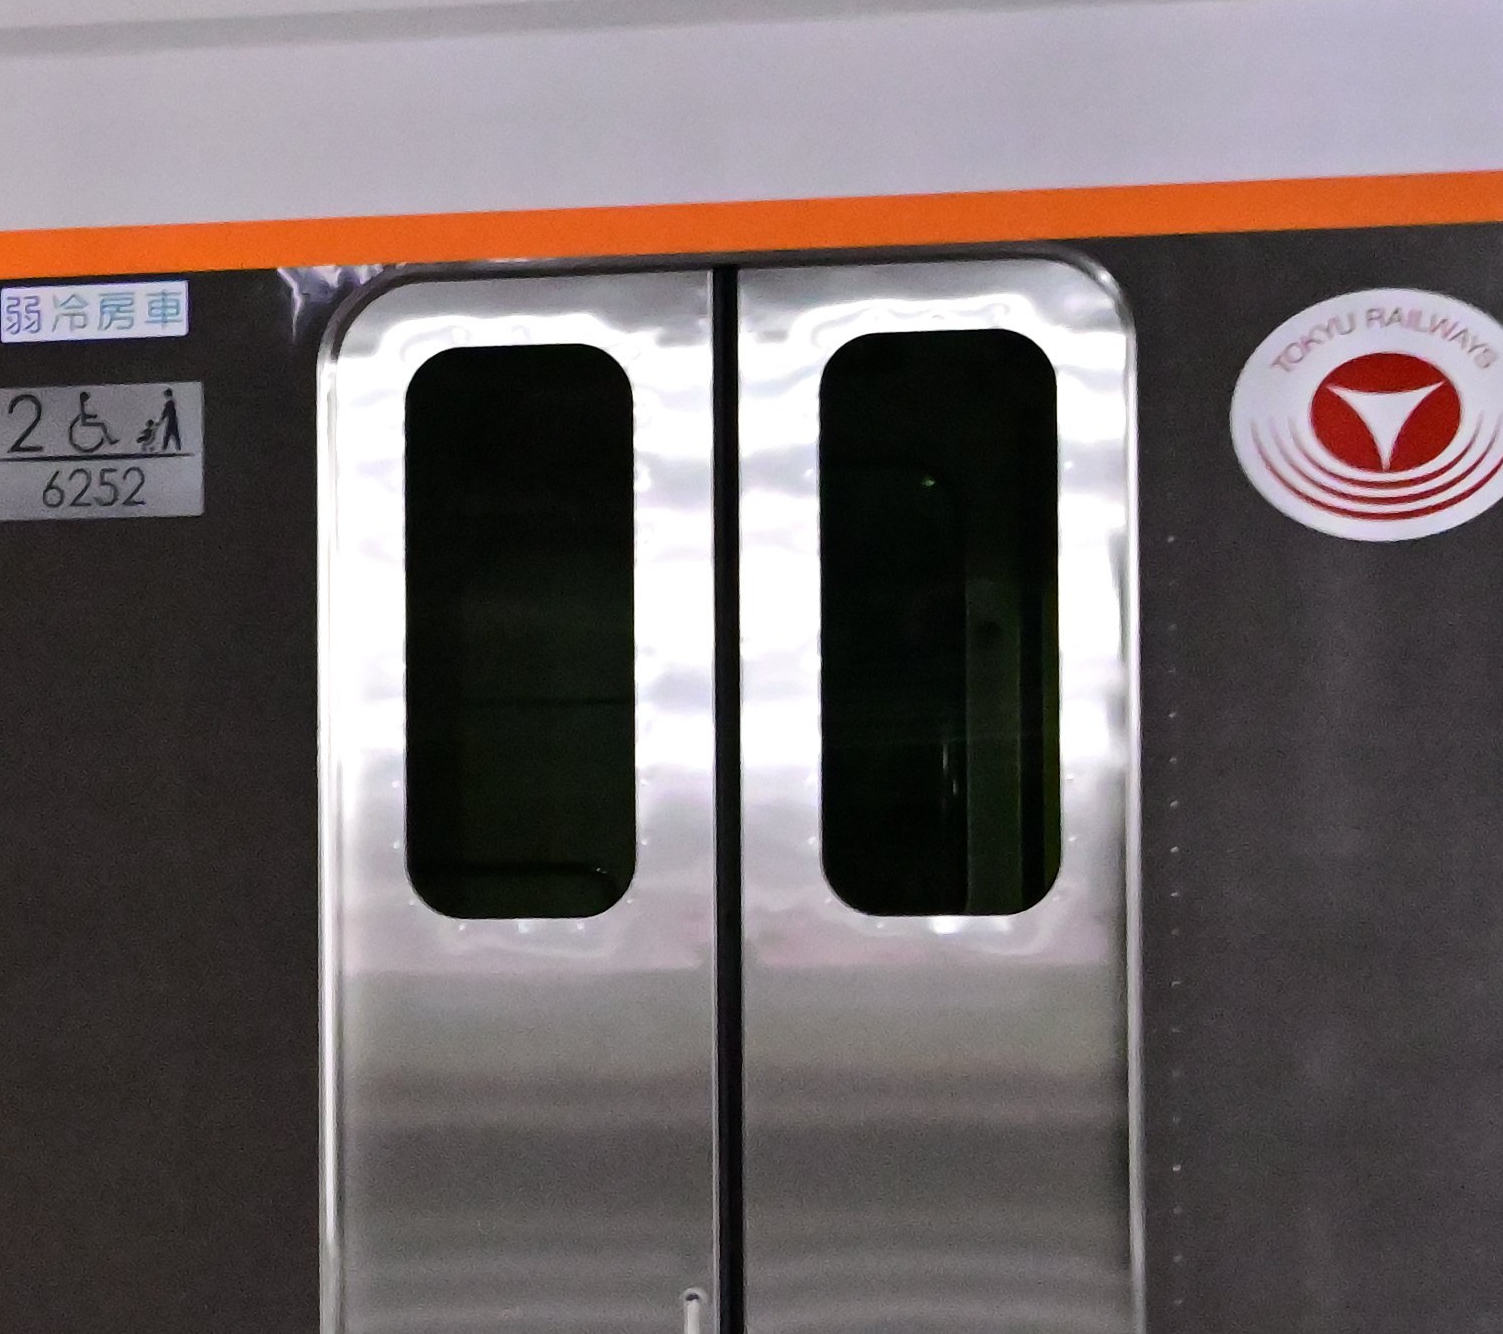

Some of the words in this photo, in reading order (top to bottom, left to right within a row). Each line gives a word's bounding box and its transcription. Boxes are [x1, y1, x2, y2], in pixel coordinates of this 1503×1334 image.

[5, 289, 184, 335] 弱冷房車
[1271, 312, 1356, 372] TOKYU
[1365, 307, 1499, 369] RAILWAYS
[6, 393, 44, 454] 2
[42, 467, 147, 509] 6252
